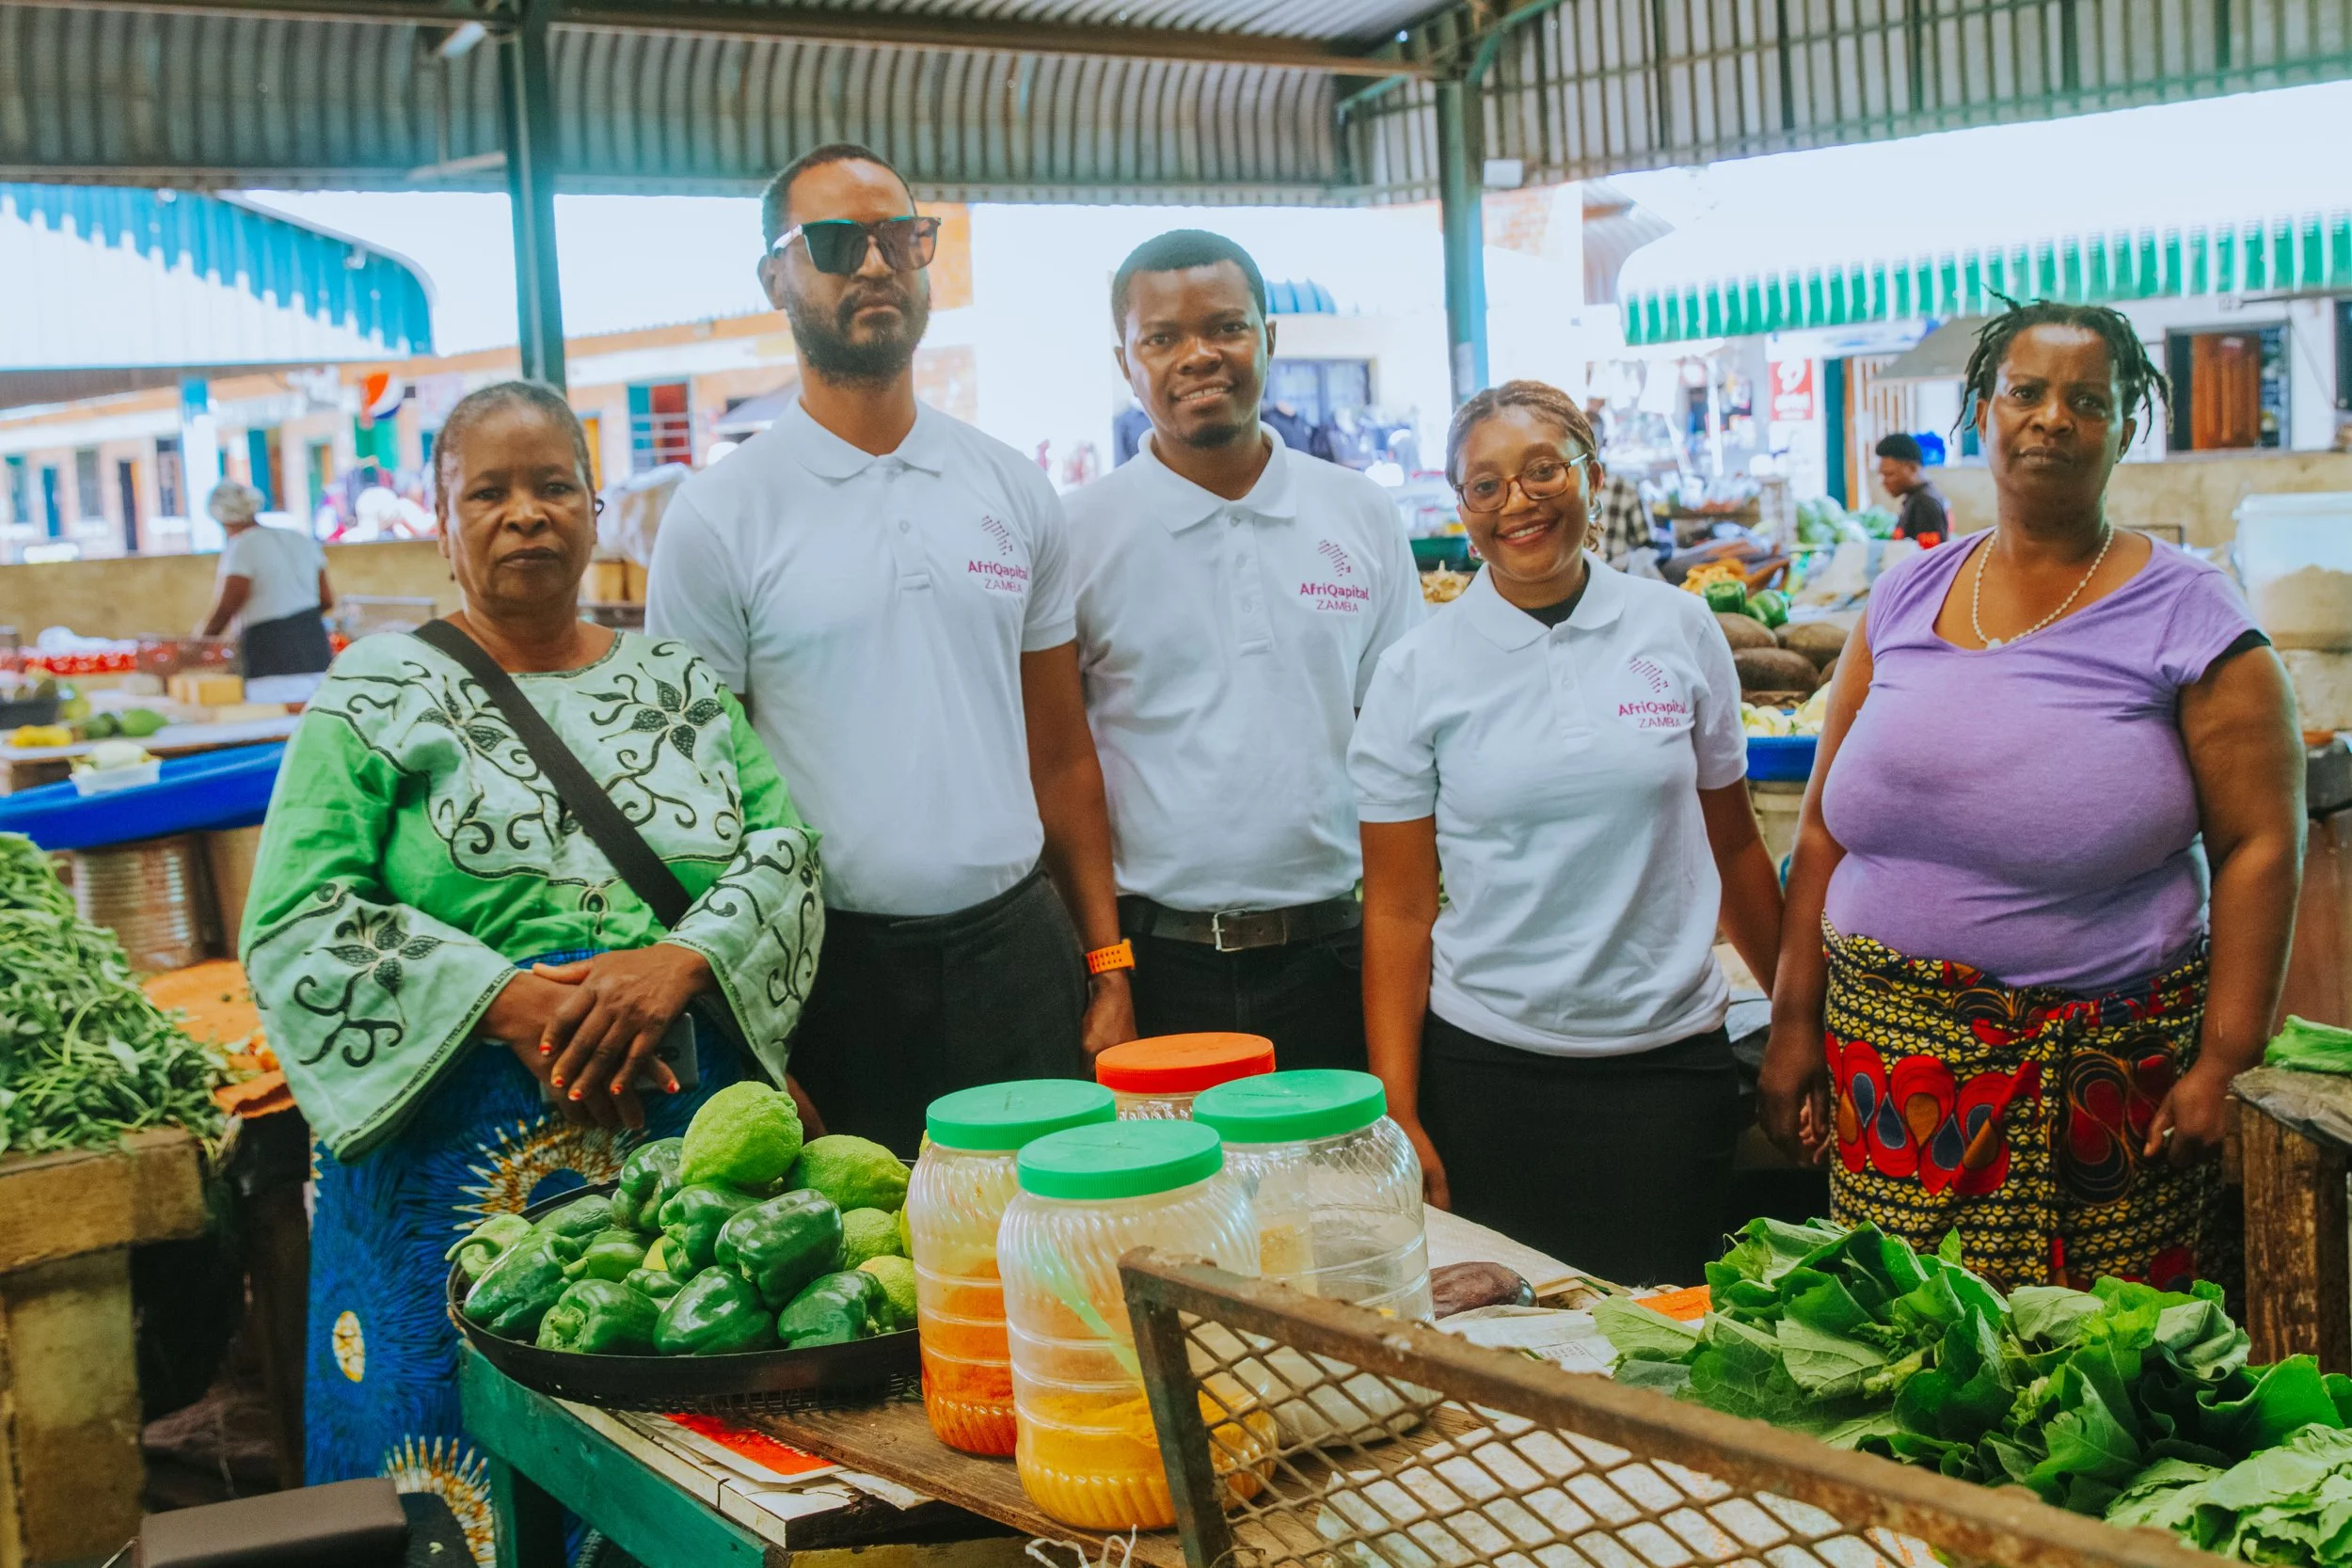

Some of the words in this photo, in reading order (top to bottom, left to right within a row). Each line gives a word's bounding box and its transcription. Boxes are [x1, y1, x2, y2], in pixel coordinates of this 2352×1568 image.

[968, 561, 1029, 579] AfriQapital
[1300, 582, 1369, 600] AfriQapital
[1316, 599, 1359, 613] ZAMBA
[1619, 700, 1687, 716] AfriQapital
[1639, 717, 1681, 728] ZAMBA
